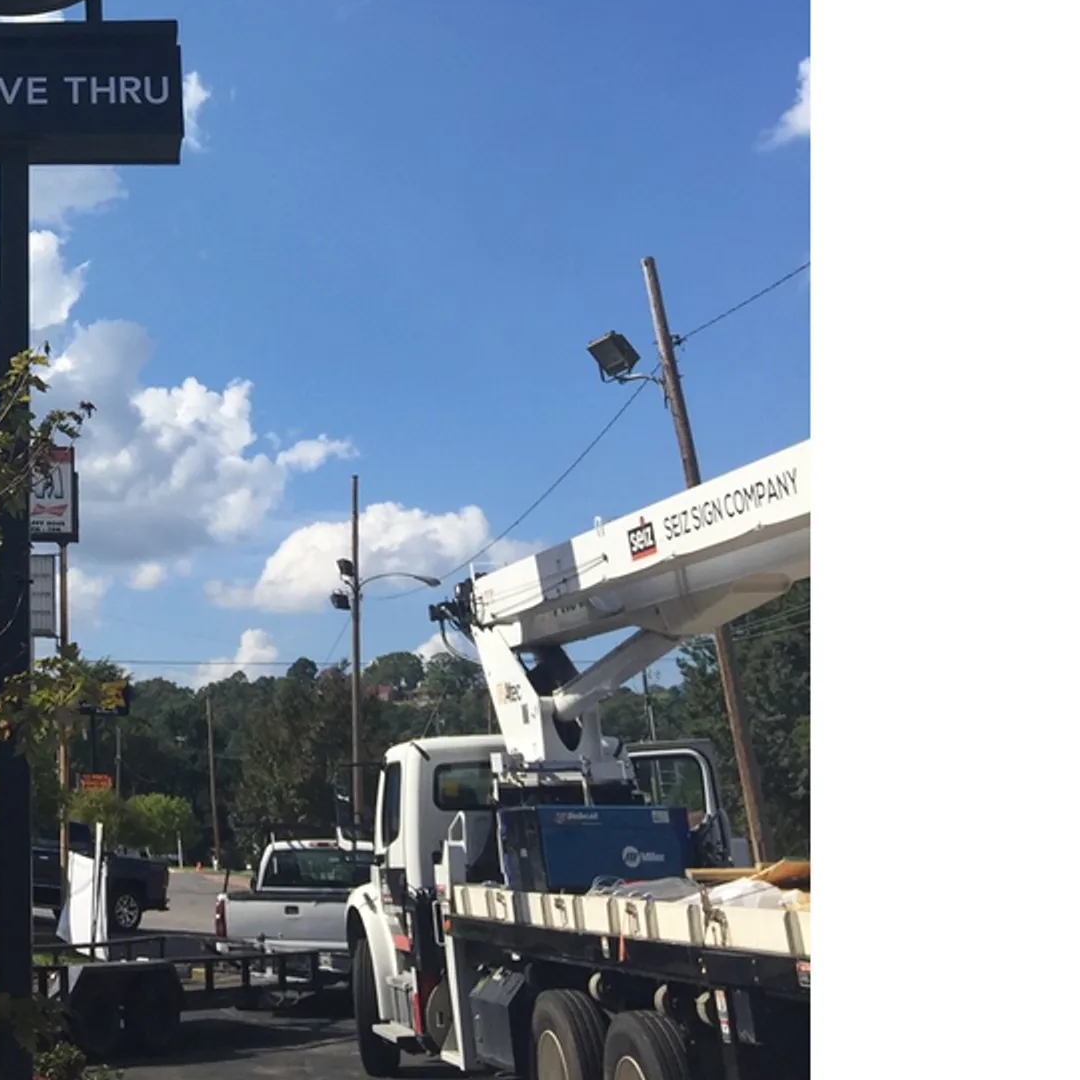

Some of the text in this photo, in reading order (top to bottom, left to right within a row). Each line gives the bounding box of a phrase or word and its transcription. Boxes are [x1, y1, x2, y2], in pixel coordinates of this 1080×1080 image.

[64, 75, 170, 105] THRU
[663, 467, 798, 541] SEIZ SIGN COMPANY
